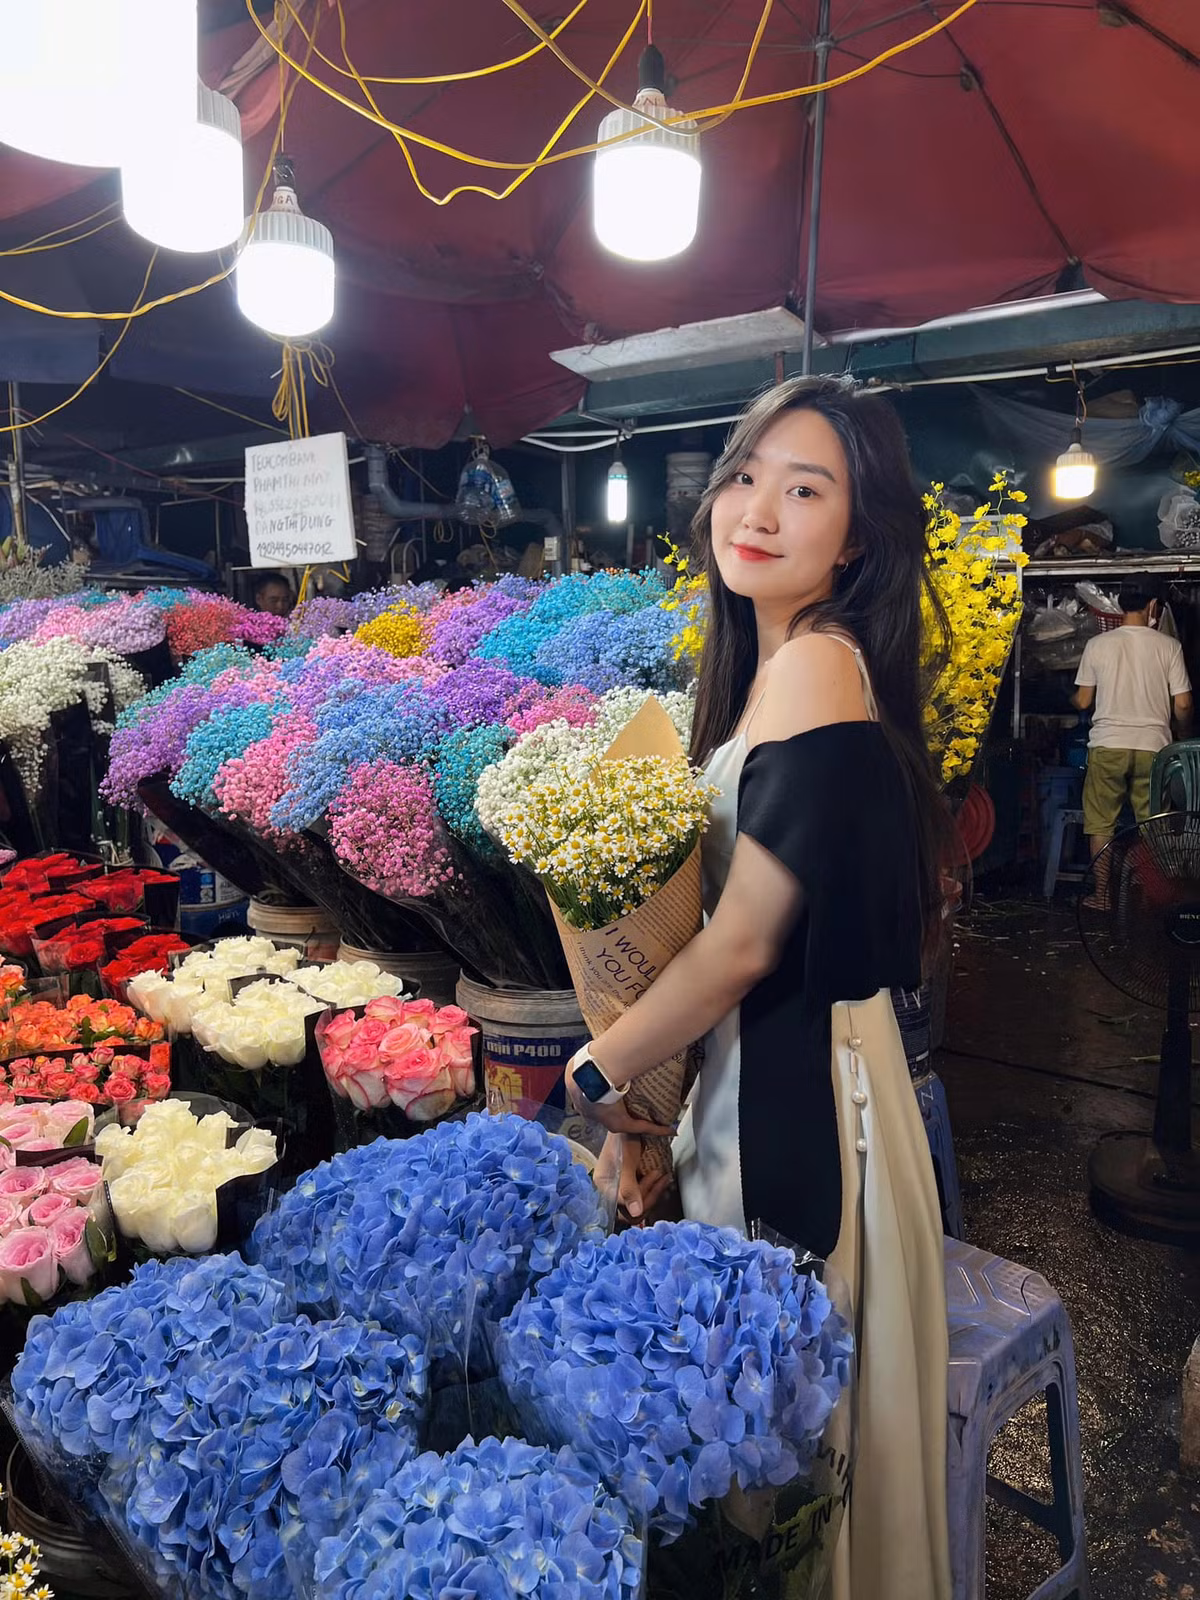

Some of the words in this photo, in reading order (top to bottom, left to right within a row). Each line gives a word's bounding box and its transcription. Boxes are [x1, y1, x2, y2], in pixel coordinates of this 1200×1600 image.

[605, 927, 619, 936] I
[596, 947, 632, 983] YOU
[590, 966, 603, 981] you
[514, 1044, 561, 1057] P400
